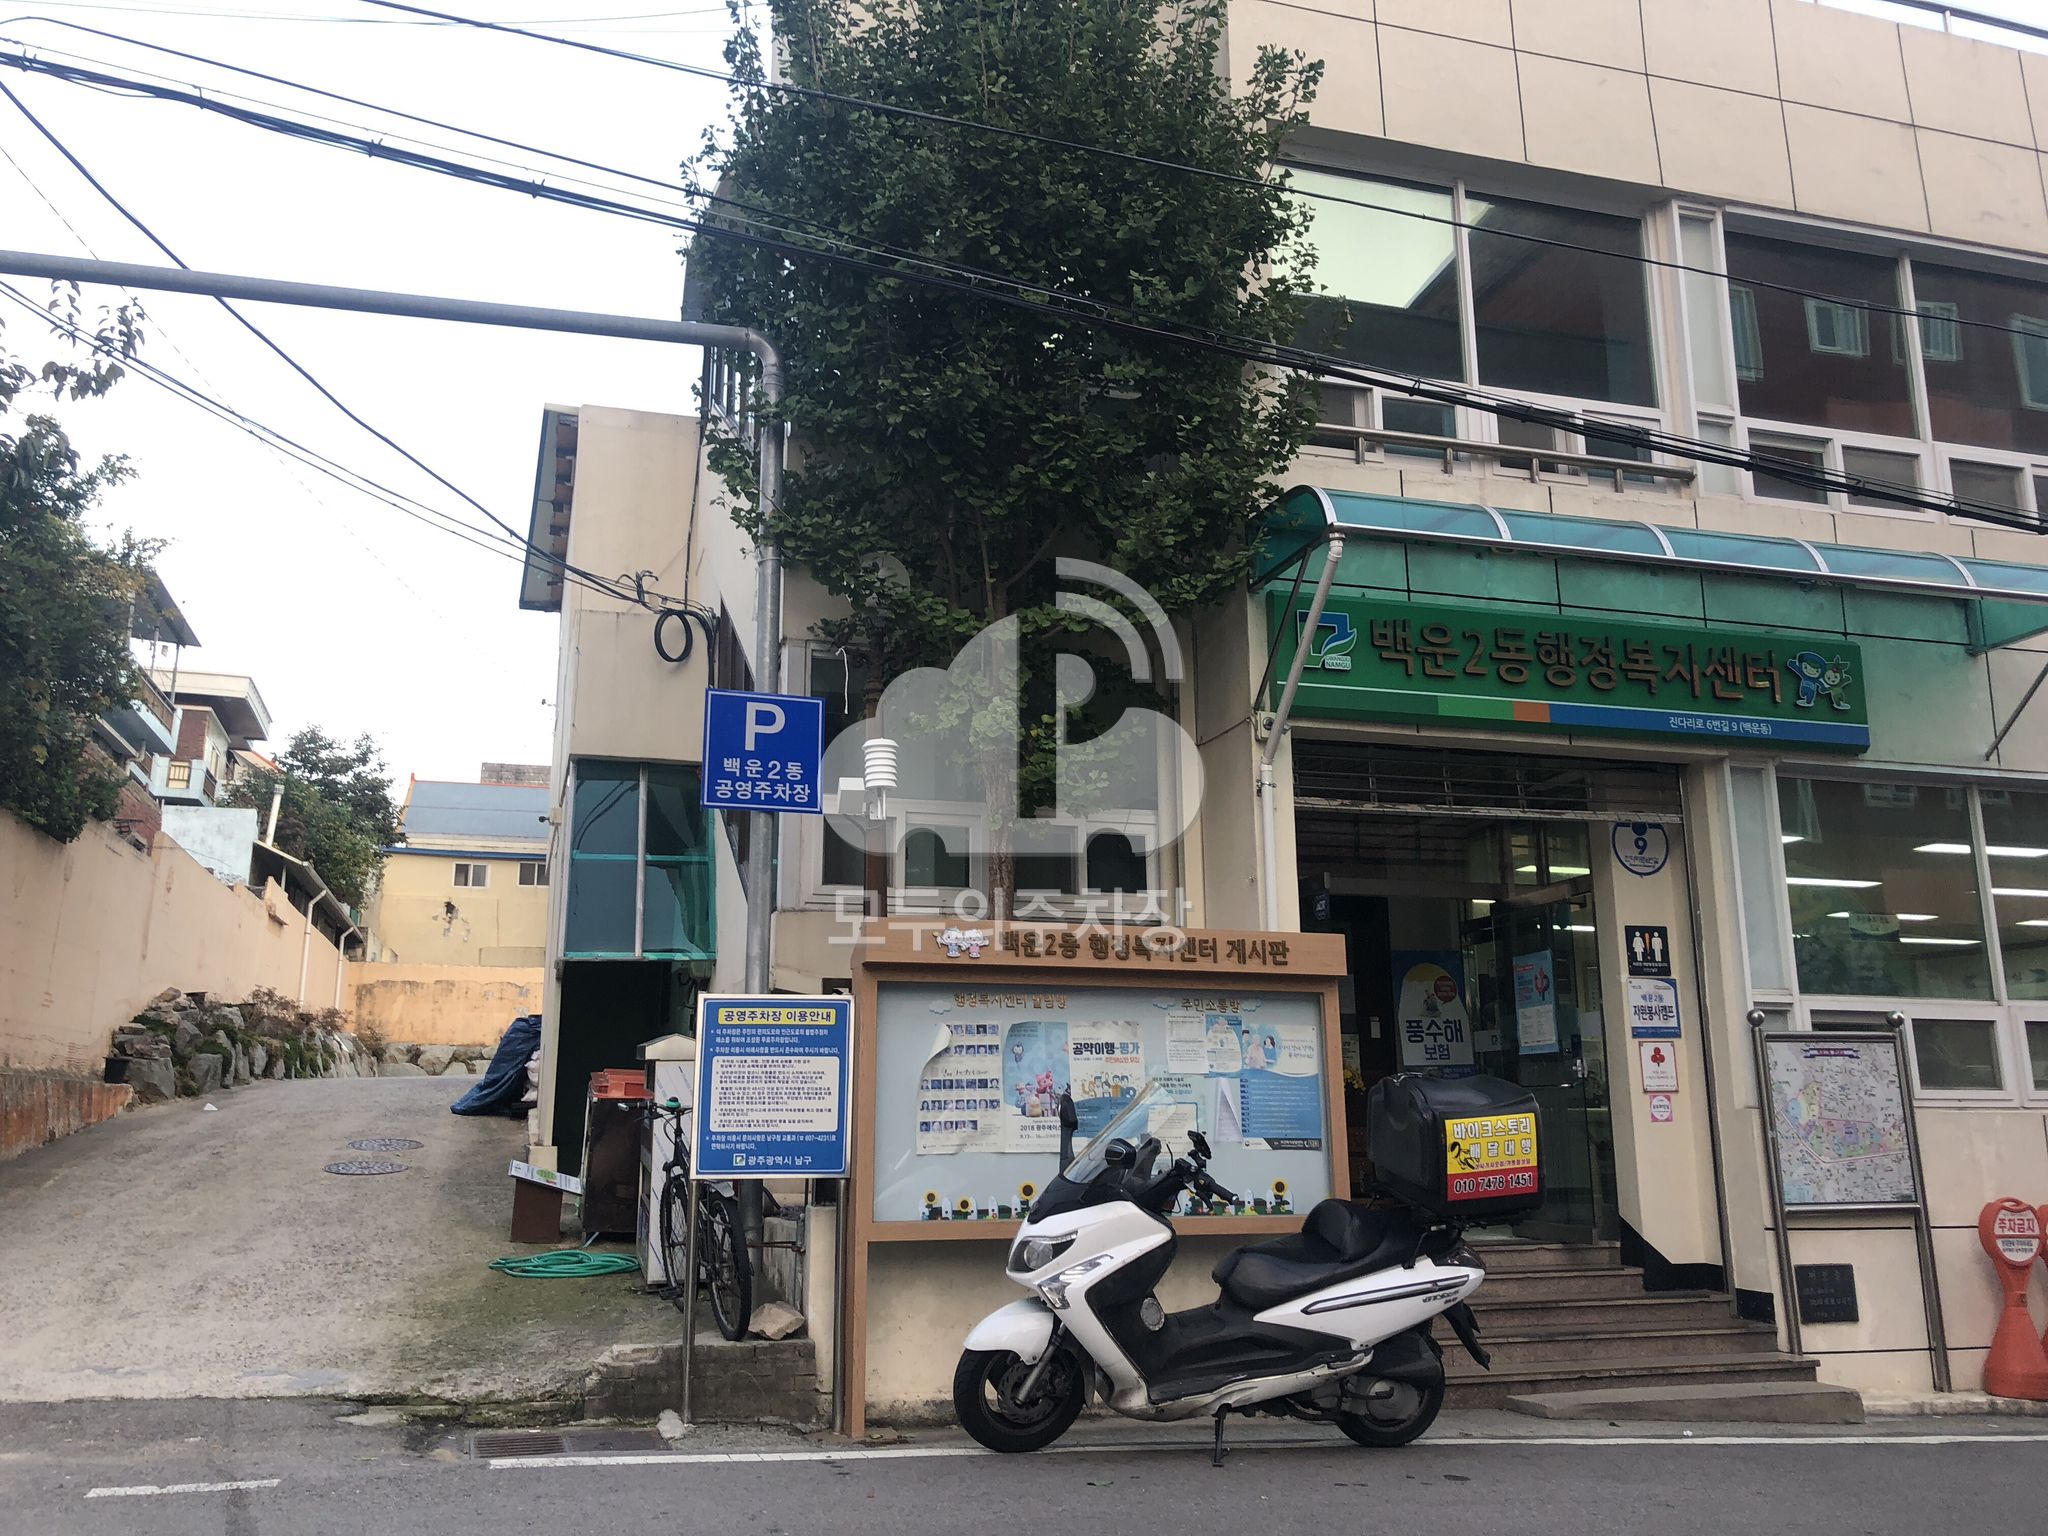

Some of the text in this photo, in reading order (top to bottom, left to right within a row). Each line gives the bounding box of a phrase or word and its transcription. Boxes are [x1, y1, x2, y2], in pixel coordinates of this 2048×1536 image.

[1325, 661, 1351, 669] NAMGU
[744, 701, 786, 752] P
[1669, 716, 1772, 736] 진다리로 6번길 9 (백운동)
[723, 756, 804, 781] 백운2동
[714, 779, 811, 803] 공영주차장
[1634, 836, 1648, 856] 9
[999, 929, 1291, 966] 백운2동 행정복지센터 게시판
[953, 992, 1028, 1009] 행정복지센터
[1181, 998, 1241, 1014] 주민소통방
[724, 1010, 832, 1022] 공영주차장 이용안내
[1633, 1004, 1675, 1022] 자원봉사캠프
[1405, 1018, 1464, 1044] 풍수해
[1072, 1041, 1115, 1055] 공약이행
[1424, 1044, 1451, 1061] 보험
[1452, 1117, 1532, 1141] 바이크스토리
[747, 1155, 813, 1166] 광주광역시 남구
[1454, 1172, 1533, 1194] 010 7478 1451
